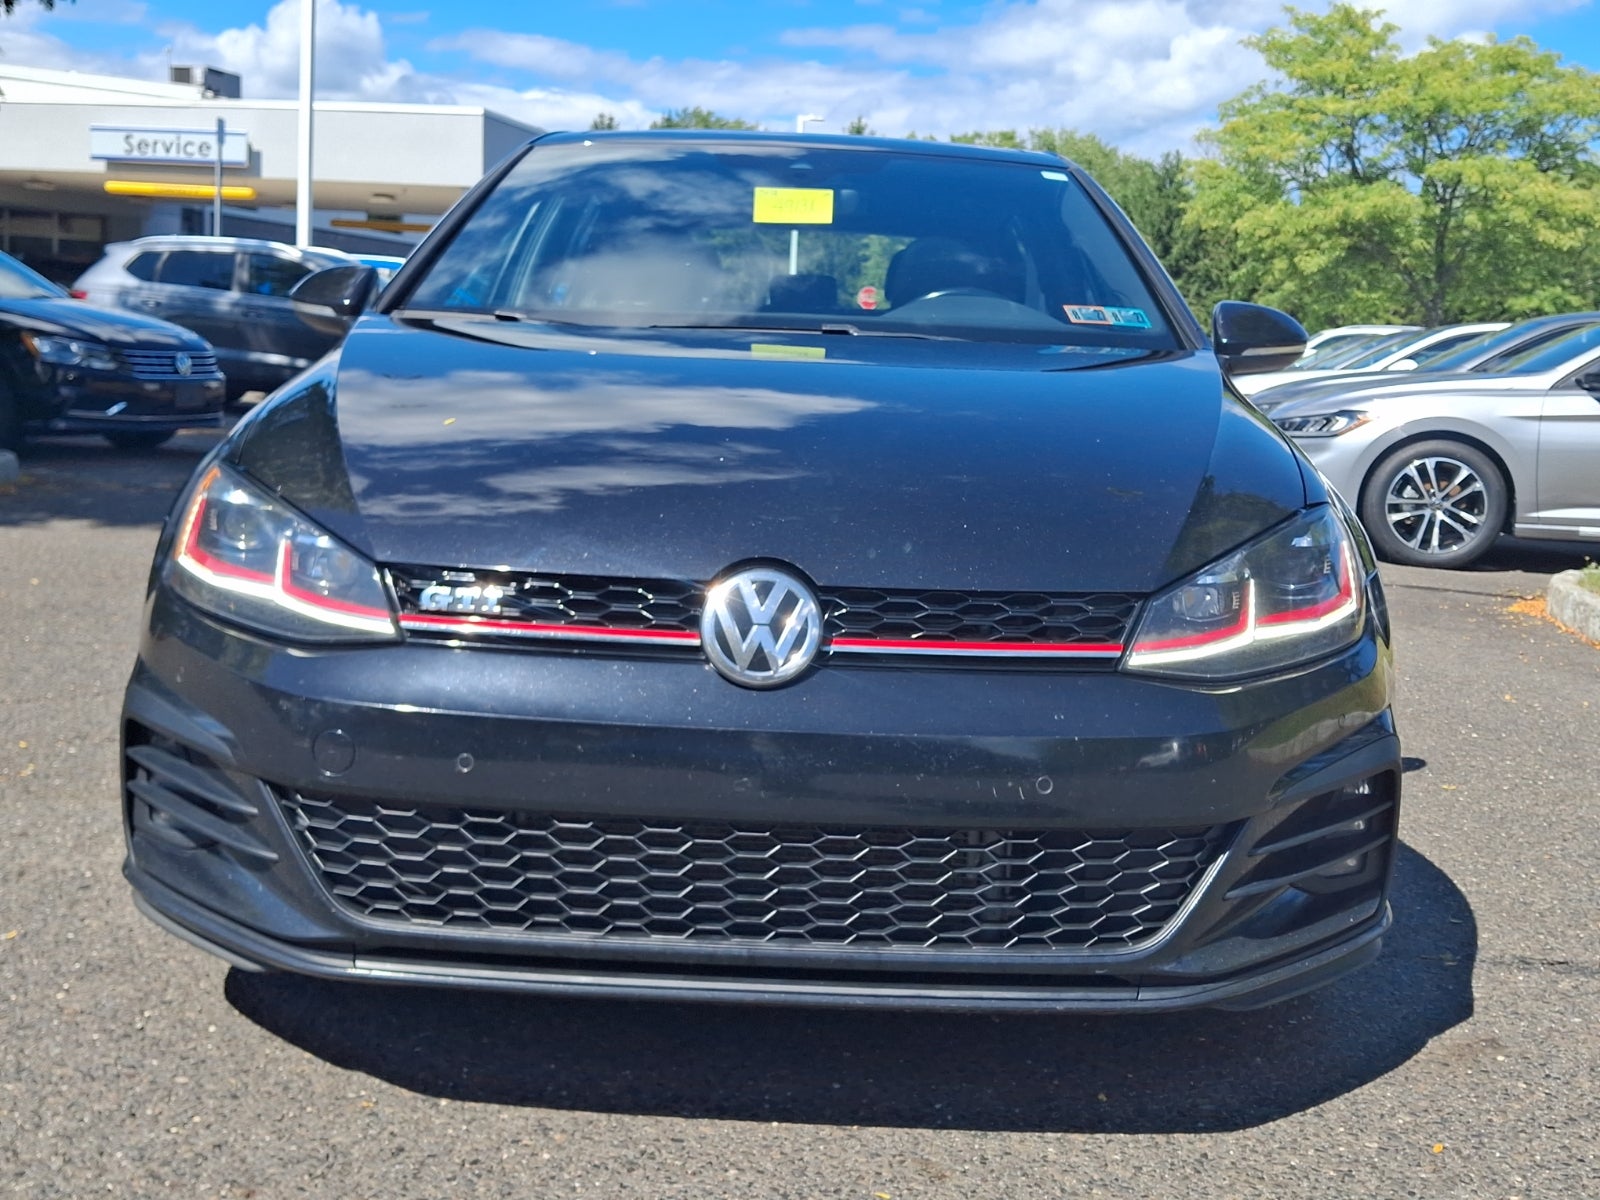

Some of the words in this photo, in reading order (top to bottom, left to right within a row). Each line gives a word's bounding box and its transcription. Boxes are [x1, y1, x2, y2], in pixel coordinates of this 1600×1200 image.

[123, 133, 211, 157] Service
[420, 585, 503, 613] GTI
[704, 569, 819, 681] VW
